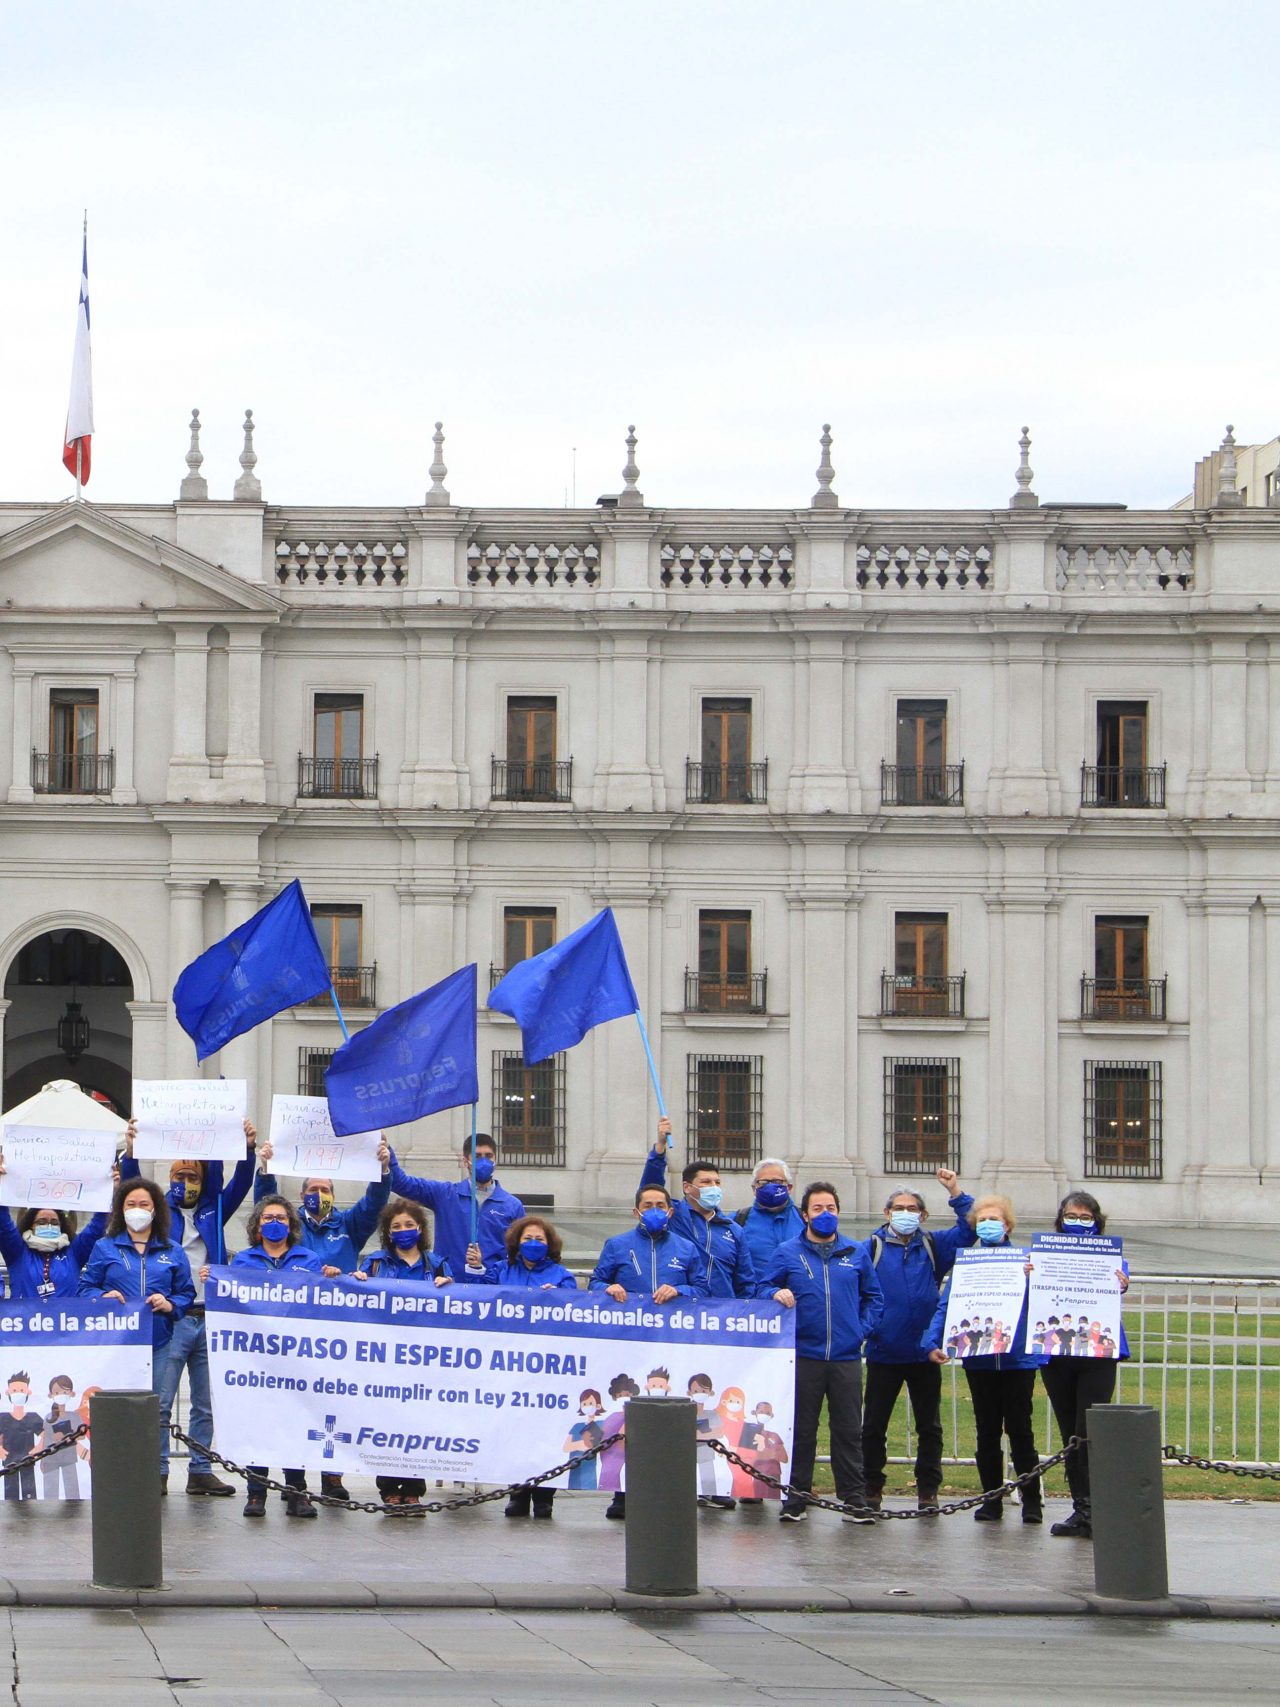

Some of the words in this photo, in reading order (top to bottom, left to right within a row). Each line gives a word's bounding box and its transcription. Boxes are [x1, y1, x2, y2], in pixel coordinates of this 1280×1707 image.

[1041, 1235, 1077, 1244] DIGNIDAD
[1079, 1238, 1112, 1246] LABORAL
[29, 1313, 54, 1331] de
[60, 1313, 79, 1331] la
[85, 1311, 140, 1331] salud
[217, 1279, 307, 1304] Dignidad
[314, 1287, 386, 1309] laboral
[391, 1296, 438, 1314] para
[444, 1296, 472, 1316] las
[478, 1302, 491, 1319] y
[496, 1299, 525, 1319] los
[530, 1303, 664, 1328] profesionales
[670, 1310, 695, 1329] de
[701, 1313, 720, 1331] la
[726, 1314, 781, 1334] salud
[211, 1330, 347, 1360] ¡TRASPASO
[355, 1341, 387, 1362] EN
[394, 1344, 482, 1370] ESPEJO
[490, 1350, 586, 1376] AHORA!
[224, 1370, 307, 1392] Gobierno
[313, 1377, 358, 1396] debe
[364, 1384, 432, 1402] cumplir
[438, 1390, 469, 1404] con
[475, 1389, 505, 1408] Ley
[510, 1391, 569, 1409] 21.106
[356, 1427, 480, 1453] Fenpruss
